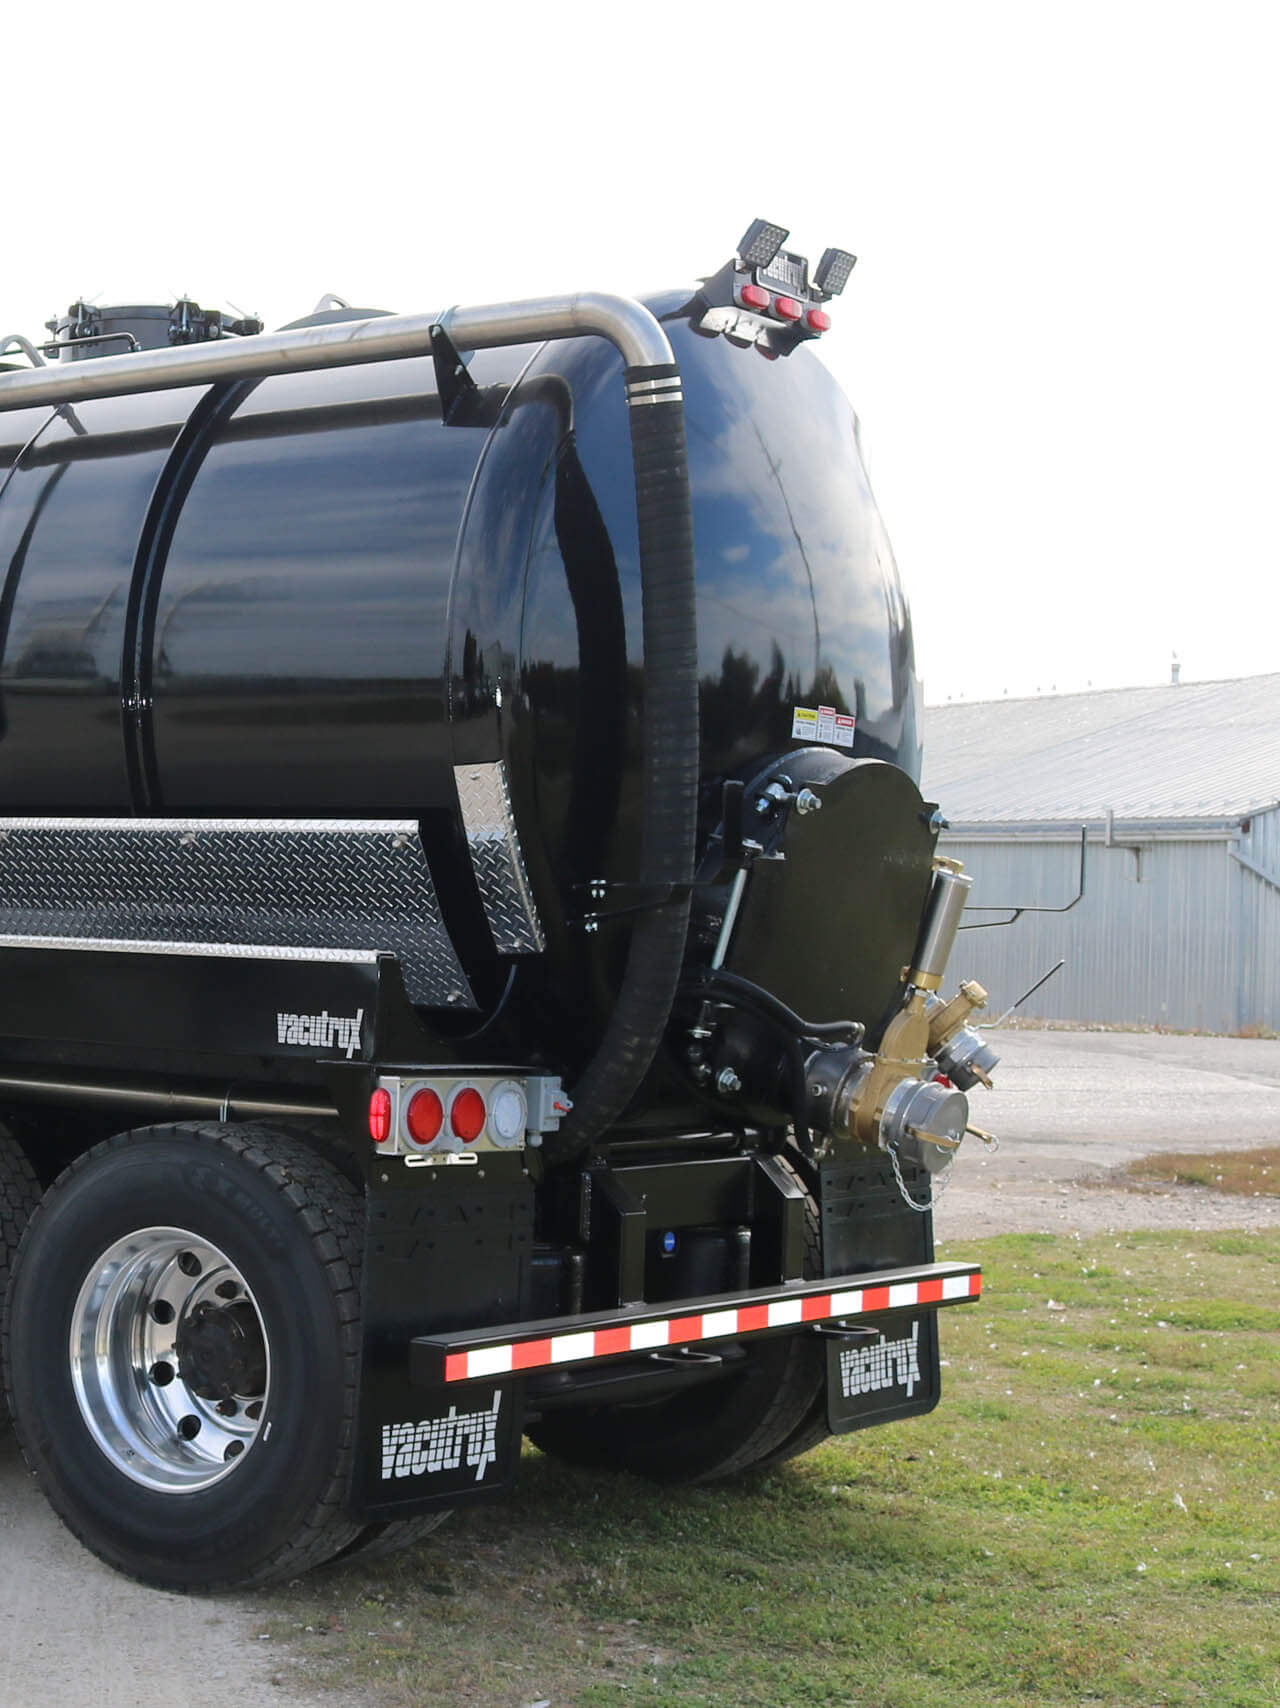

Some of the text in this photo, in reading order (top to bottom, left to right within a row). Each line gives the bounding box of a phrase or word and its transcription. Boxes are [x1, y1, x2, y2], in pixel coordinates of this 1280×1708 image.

[276, 1008, 364, 1060] vacutrux
[839, 1320, 921, 1398] vacutrux
[382, 1389, 502, 1481] vacutrux
